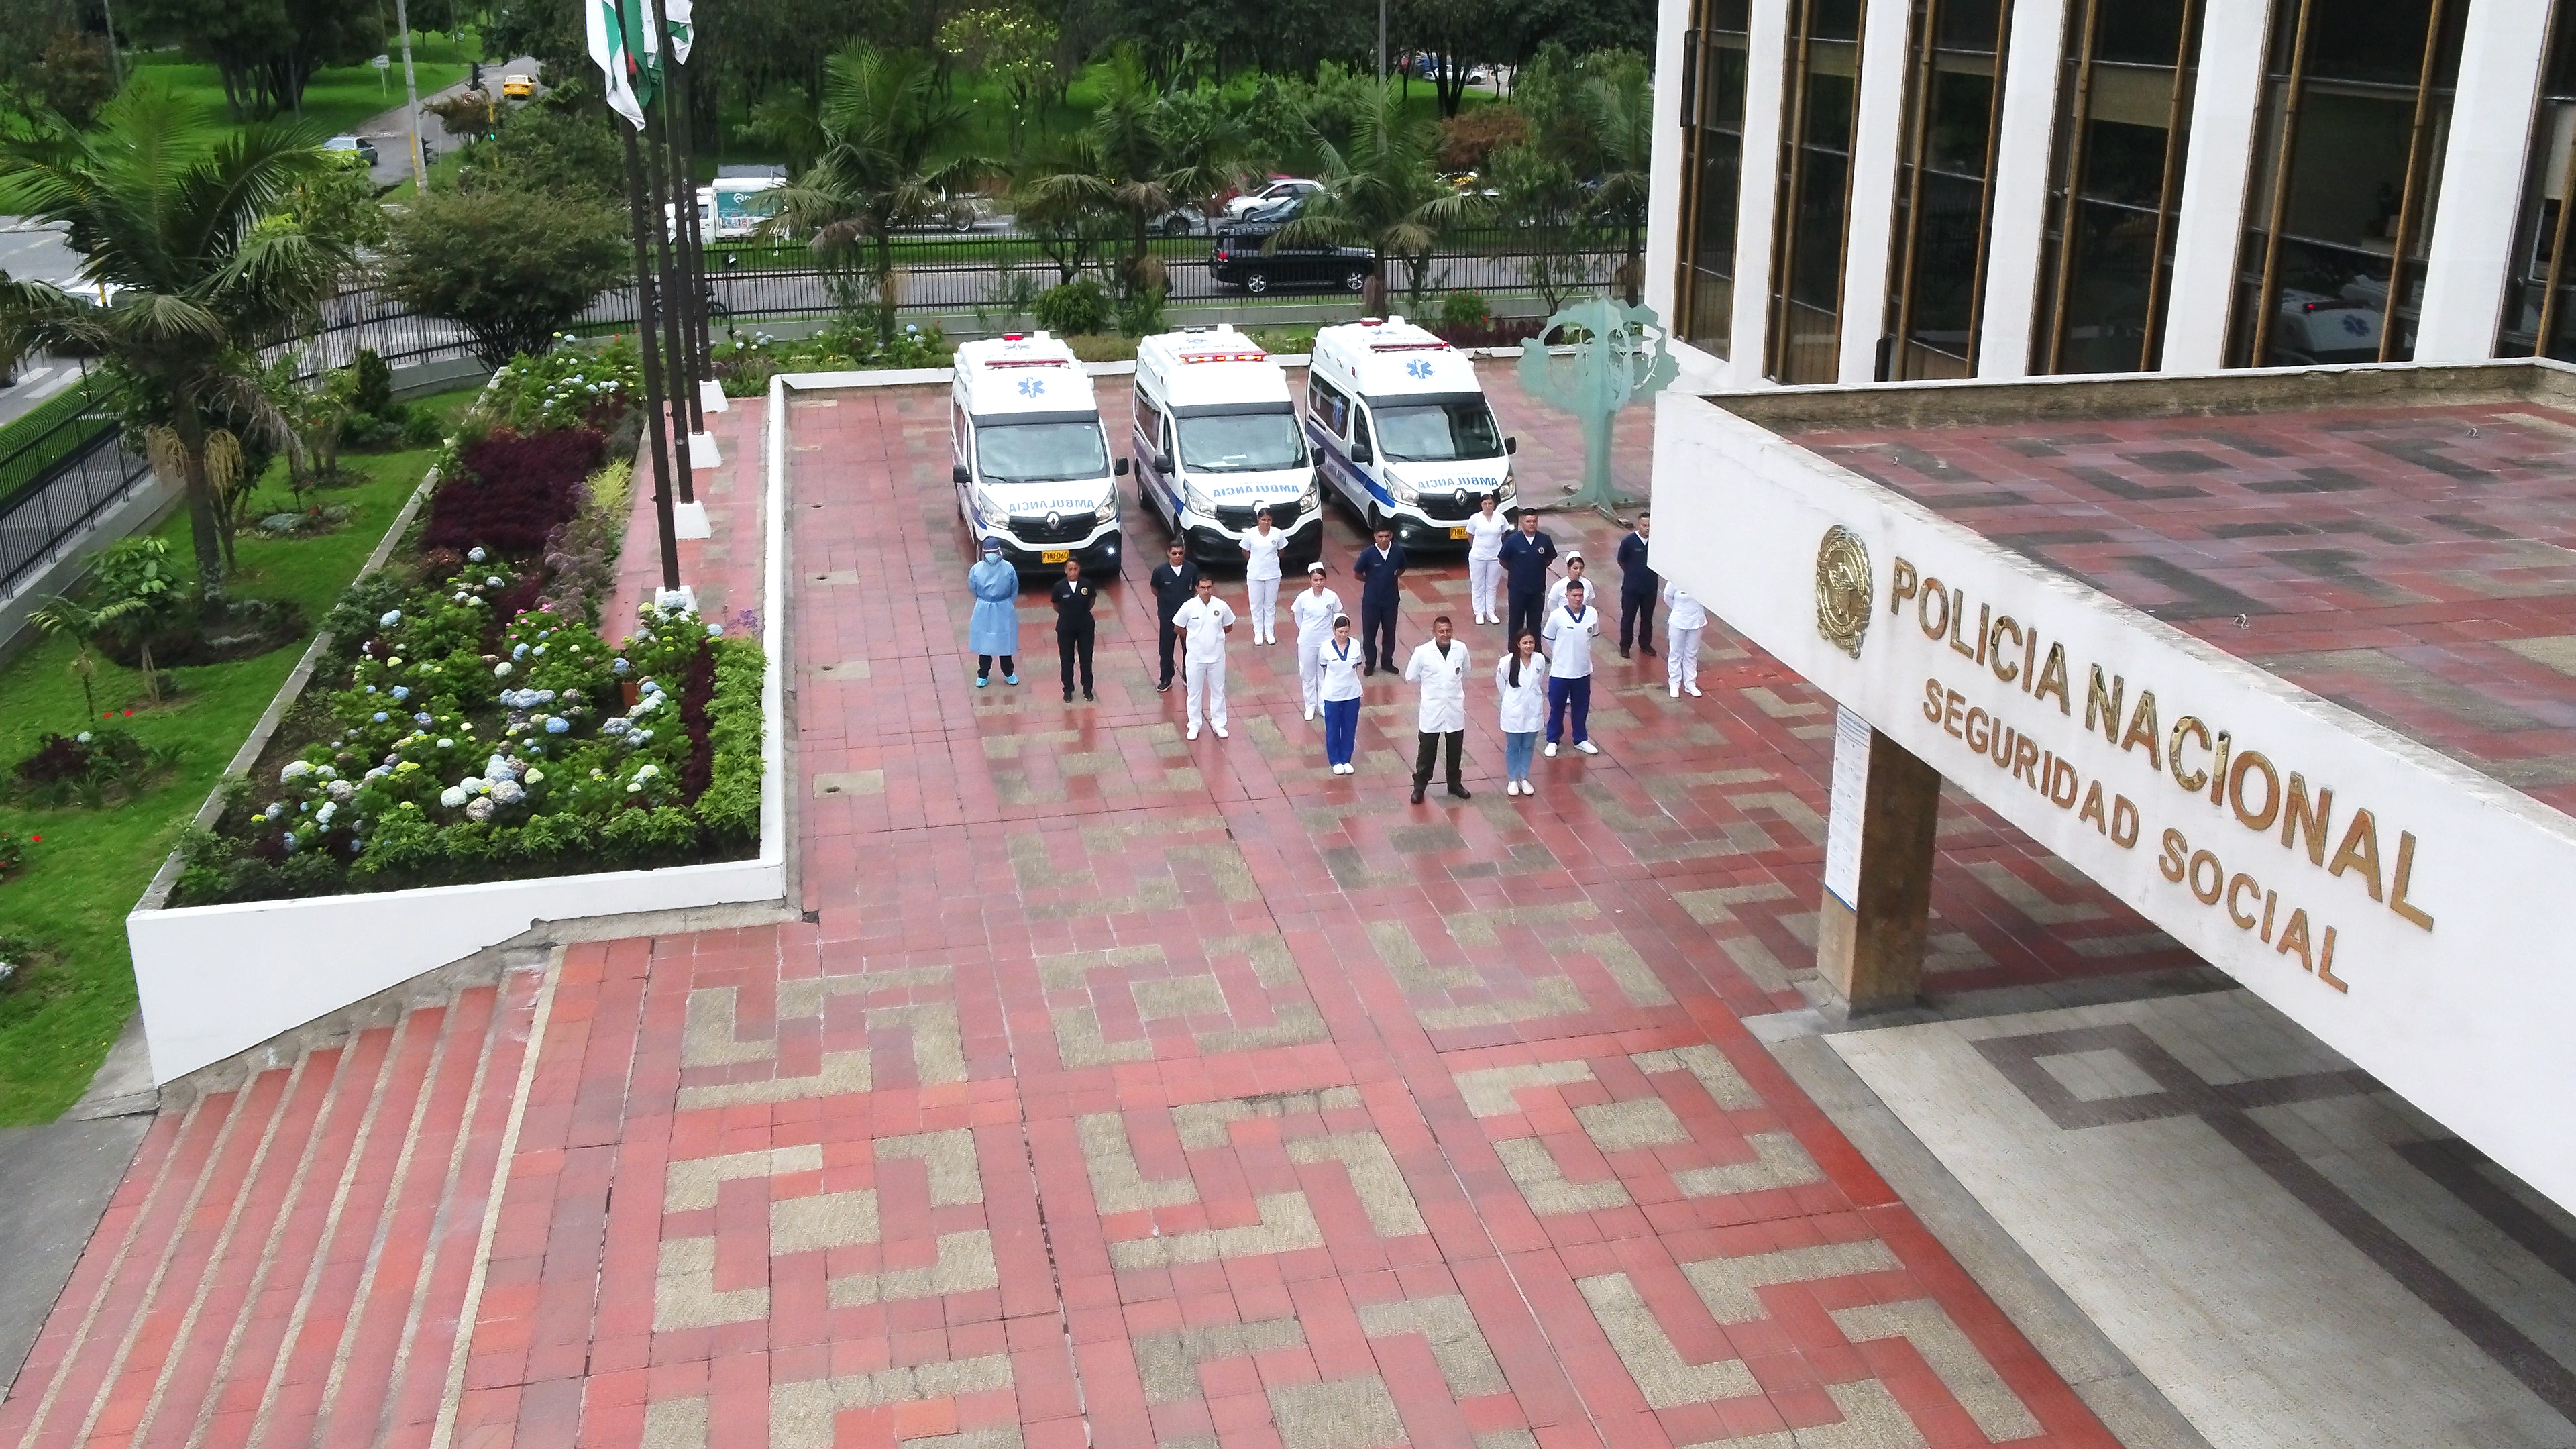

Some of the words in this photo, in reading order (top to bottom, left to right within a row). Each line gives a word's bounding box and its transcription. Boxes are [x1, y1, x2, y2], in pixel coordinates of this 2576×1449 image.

[1890, 556, 2071, 717] POLICIA
[2084, 663, 2434, 932] NACIONAL
[1923, 678, 2139, 849] SEGURIDAD
[2159, 828, 2349, 994] SOCIAL
